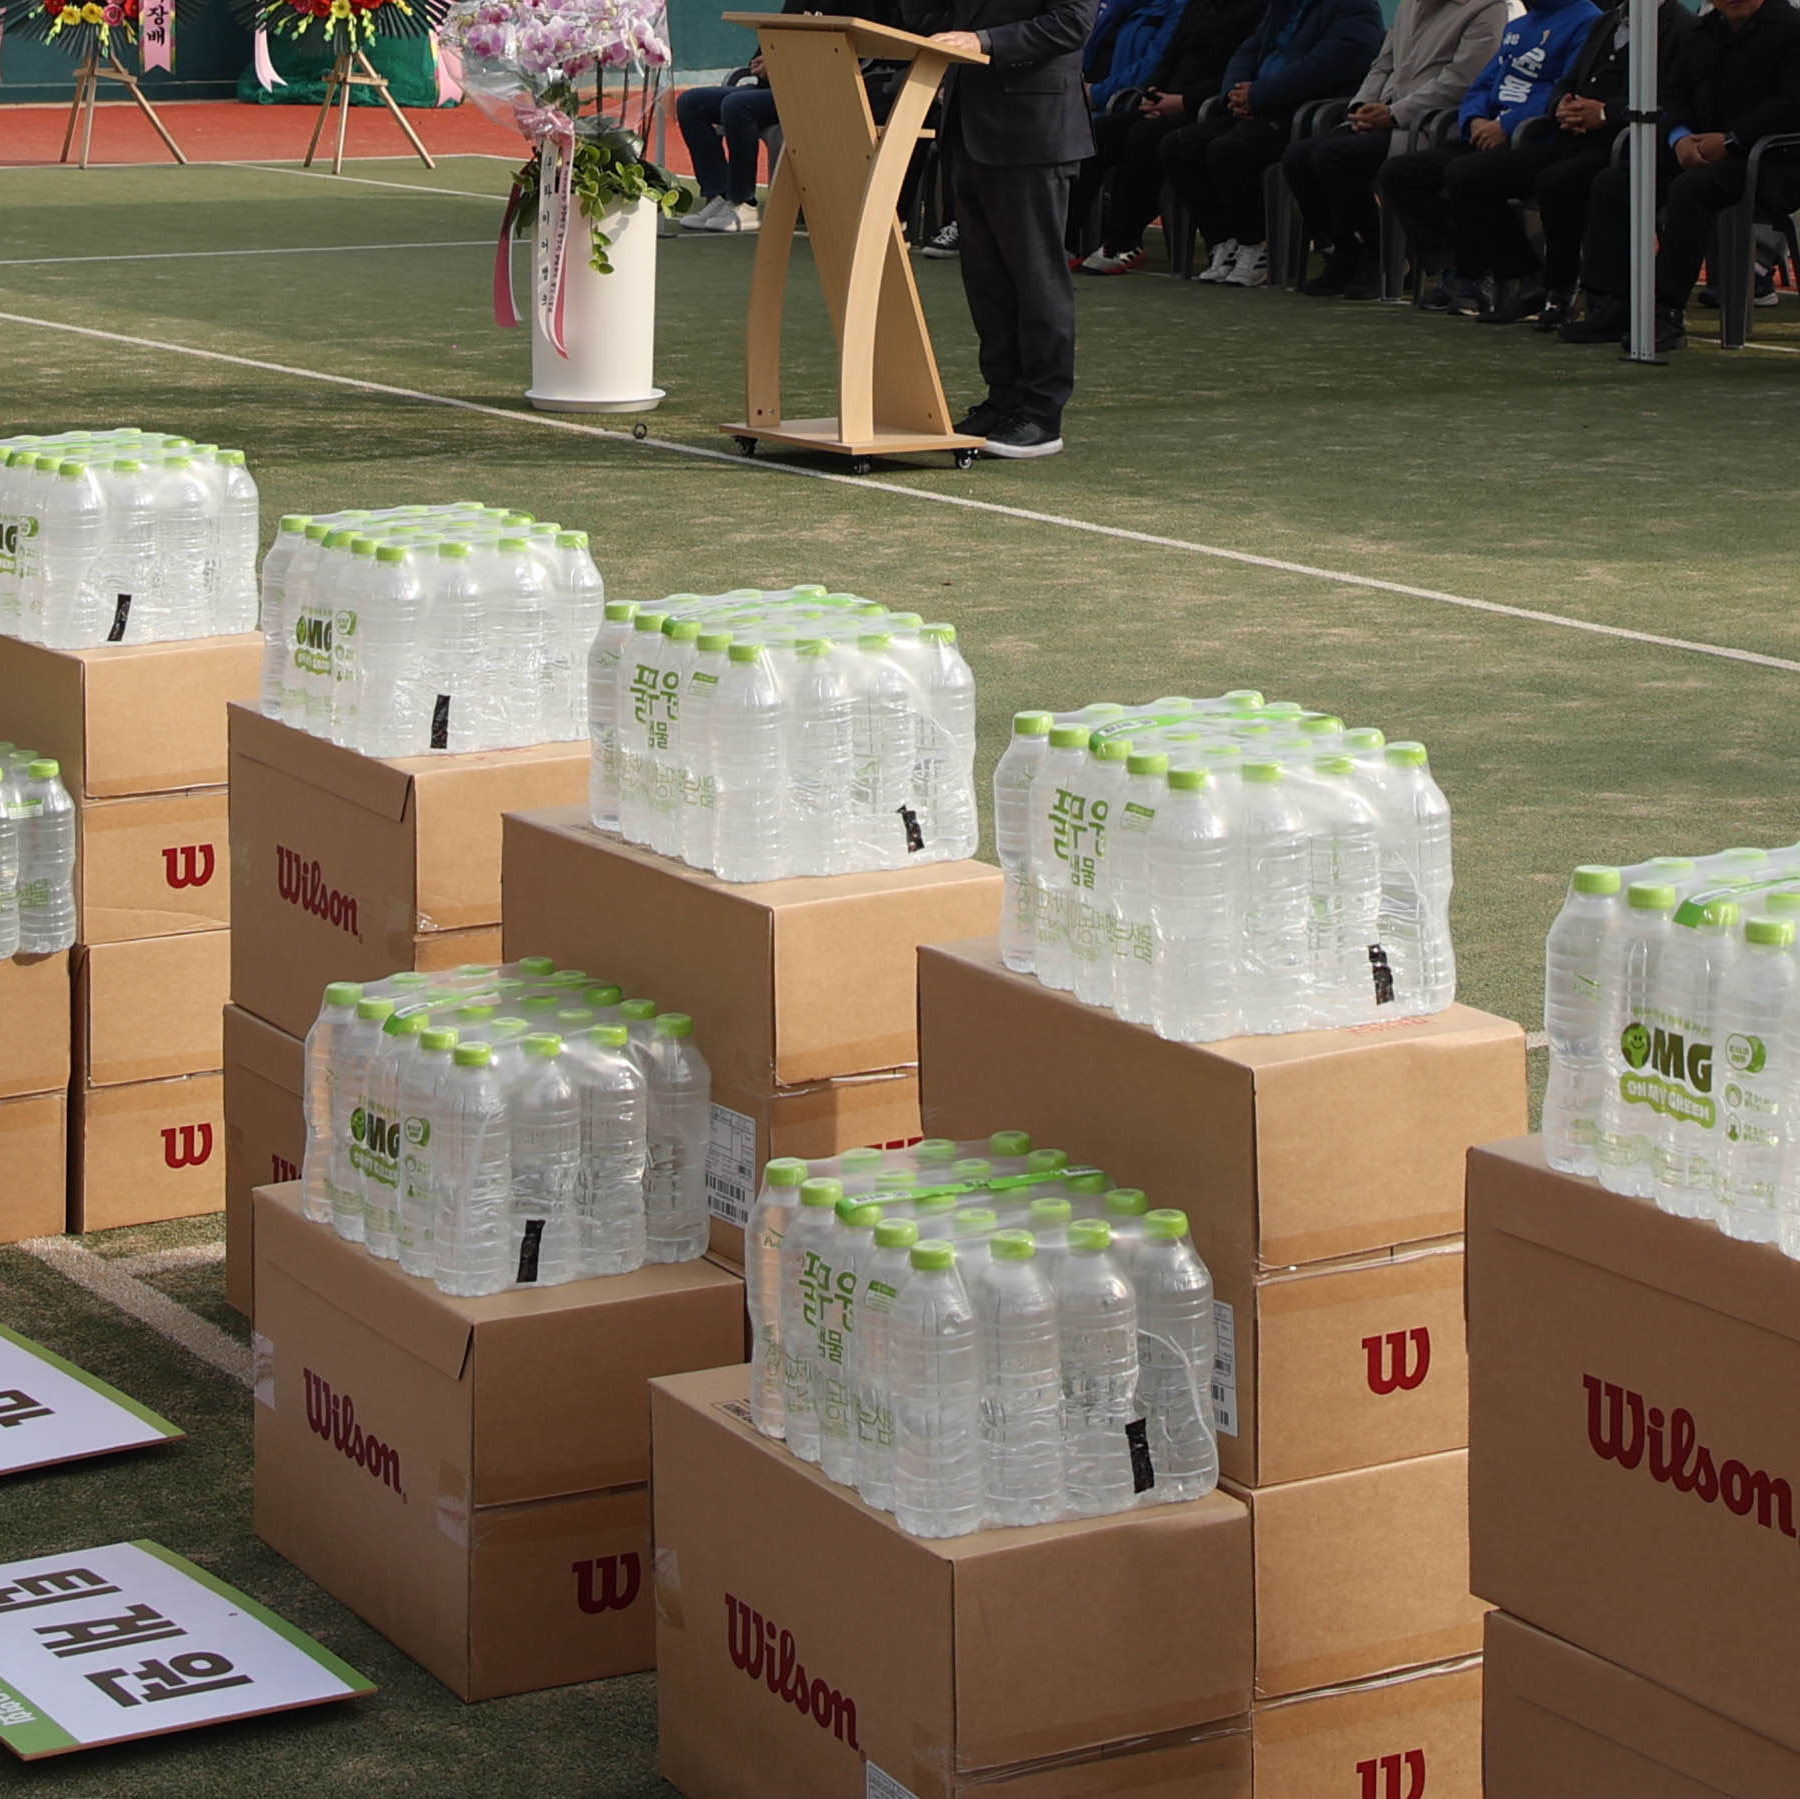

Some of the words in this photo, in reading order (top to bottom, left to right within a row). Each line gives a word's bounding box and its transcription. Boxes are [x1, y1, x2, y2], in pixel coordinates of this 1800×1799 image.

[276, 843, 361, 938] Wilson
[1620, 1021, 1714, 1094] OMG
[302, 1365, 404, 1494] Wilson
[1582, 1372, 1798, 1541] Wilson
[724, 1590, 859, 1754] Wilson
